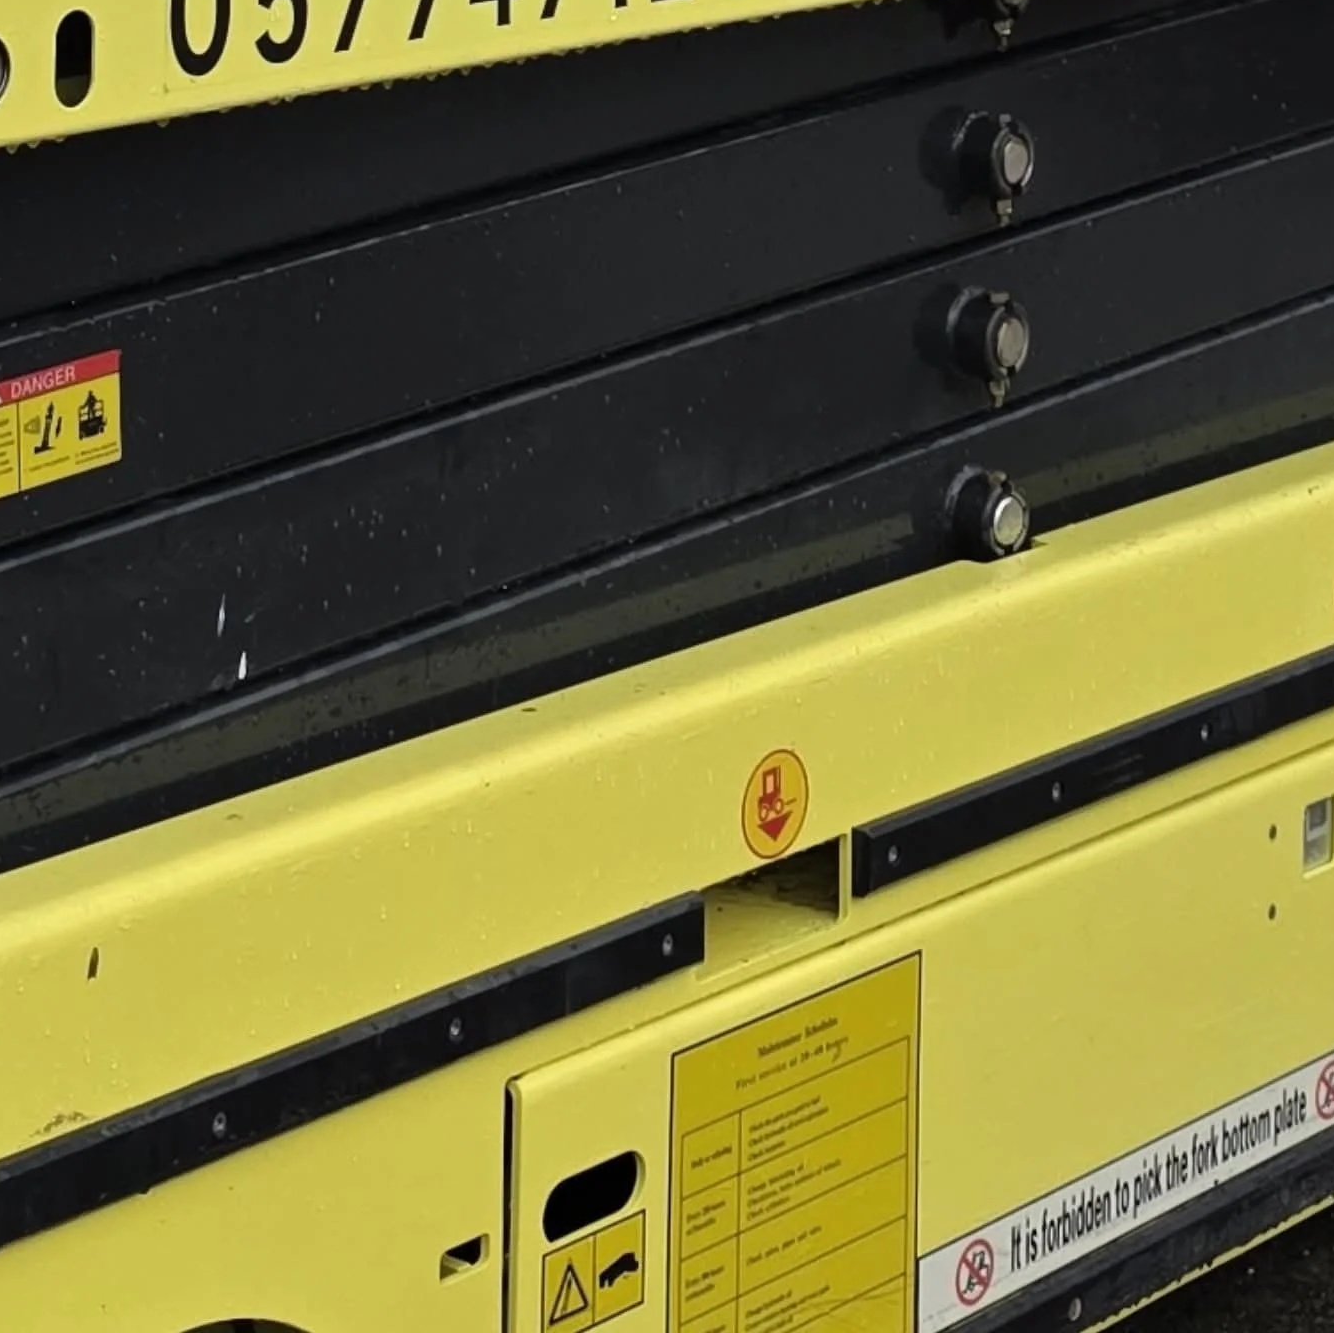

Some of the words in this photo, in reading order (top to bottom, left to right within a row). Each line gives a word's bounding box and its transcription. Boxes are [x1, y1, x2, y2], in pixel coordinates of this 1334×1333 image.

[10, 365, 76, 398] DANGER
[1010, 1225, 1022, 1272] It
[1025, 1218, 1038, 1265] is
[1041, 1185, 1111, 1257] forbidden
[1115, 1178, 1130, 1217] to
[1133, 1153, 1162, 1219] pick
[1165, 1145, 1188, 1192] the
[1191, 1124, 1219, 1179] fork
[1222, 1108, 1270, 1162] bottom
[1273, 1088, 1307, 1147] plate
